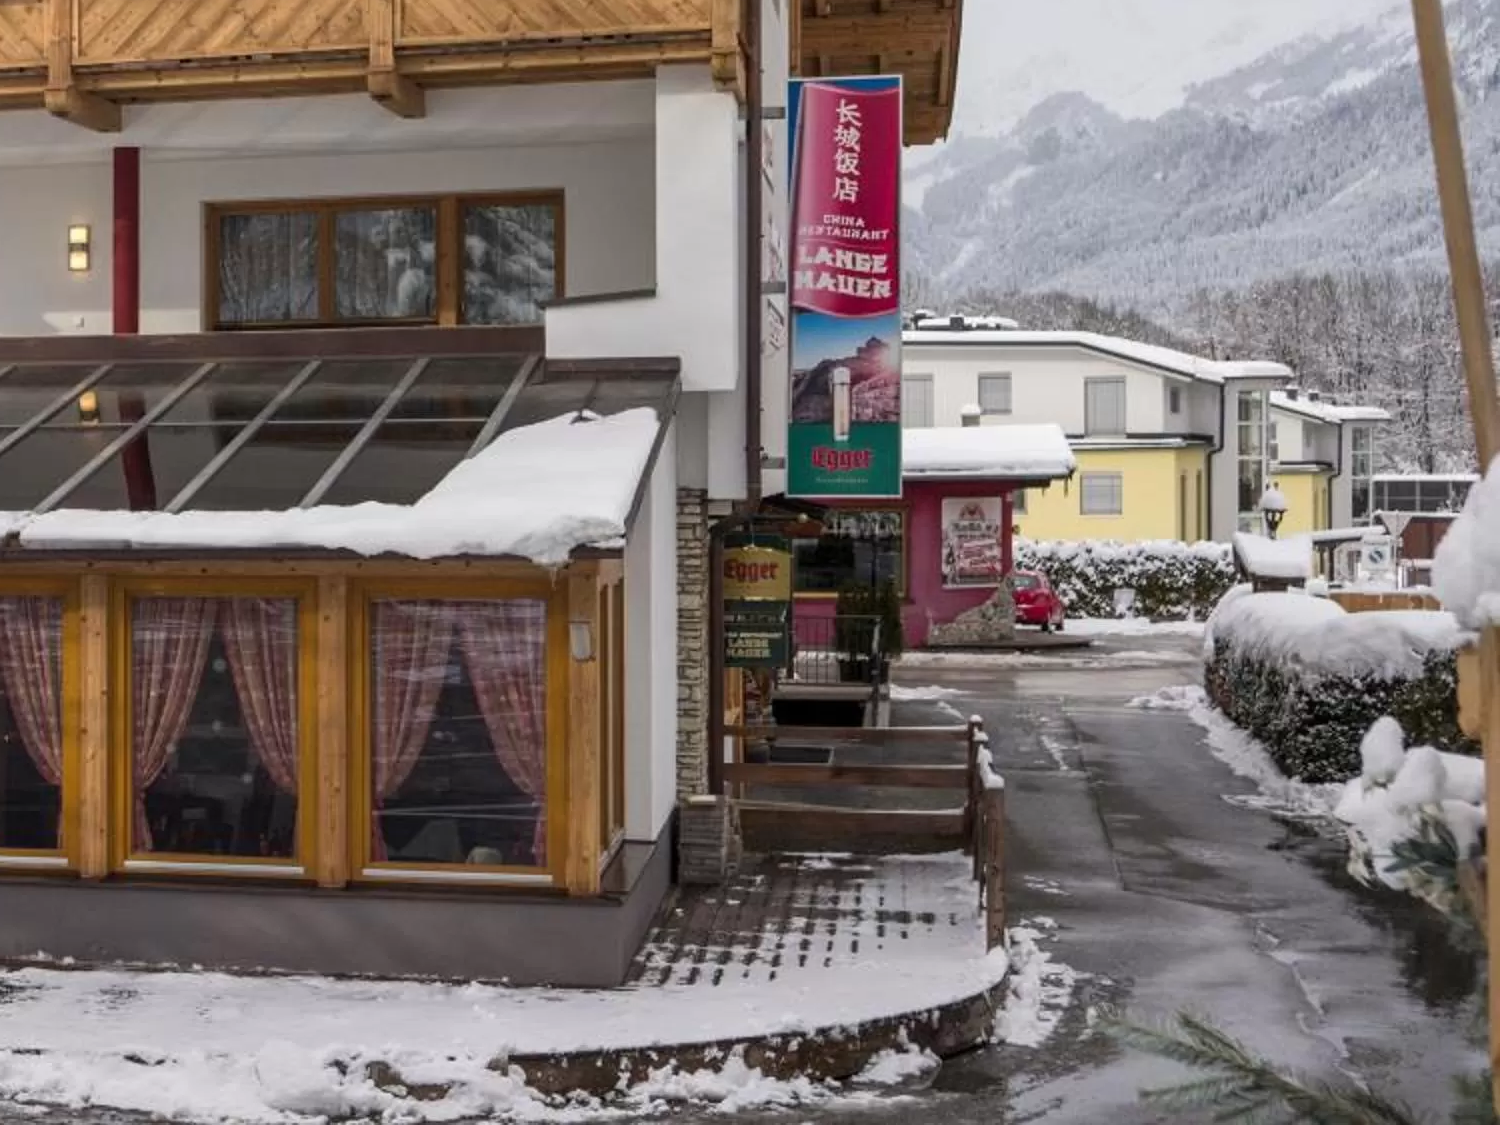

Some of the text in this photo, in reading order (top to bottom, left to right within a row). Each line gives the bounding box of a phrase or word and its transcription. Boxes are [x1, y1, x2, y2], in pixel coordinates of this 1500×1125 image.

[823, 214, 865, 228] CHINA
[799, 245, 888, 274] LANGE
[794, 270, 893, 299] MAUER
[724, 559, 779, 583] Egger
